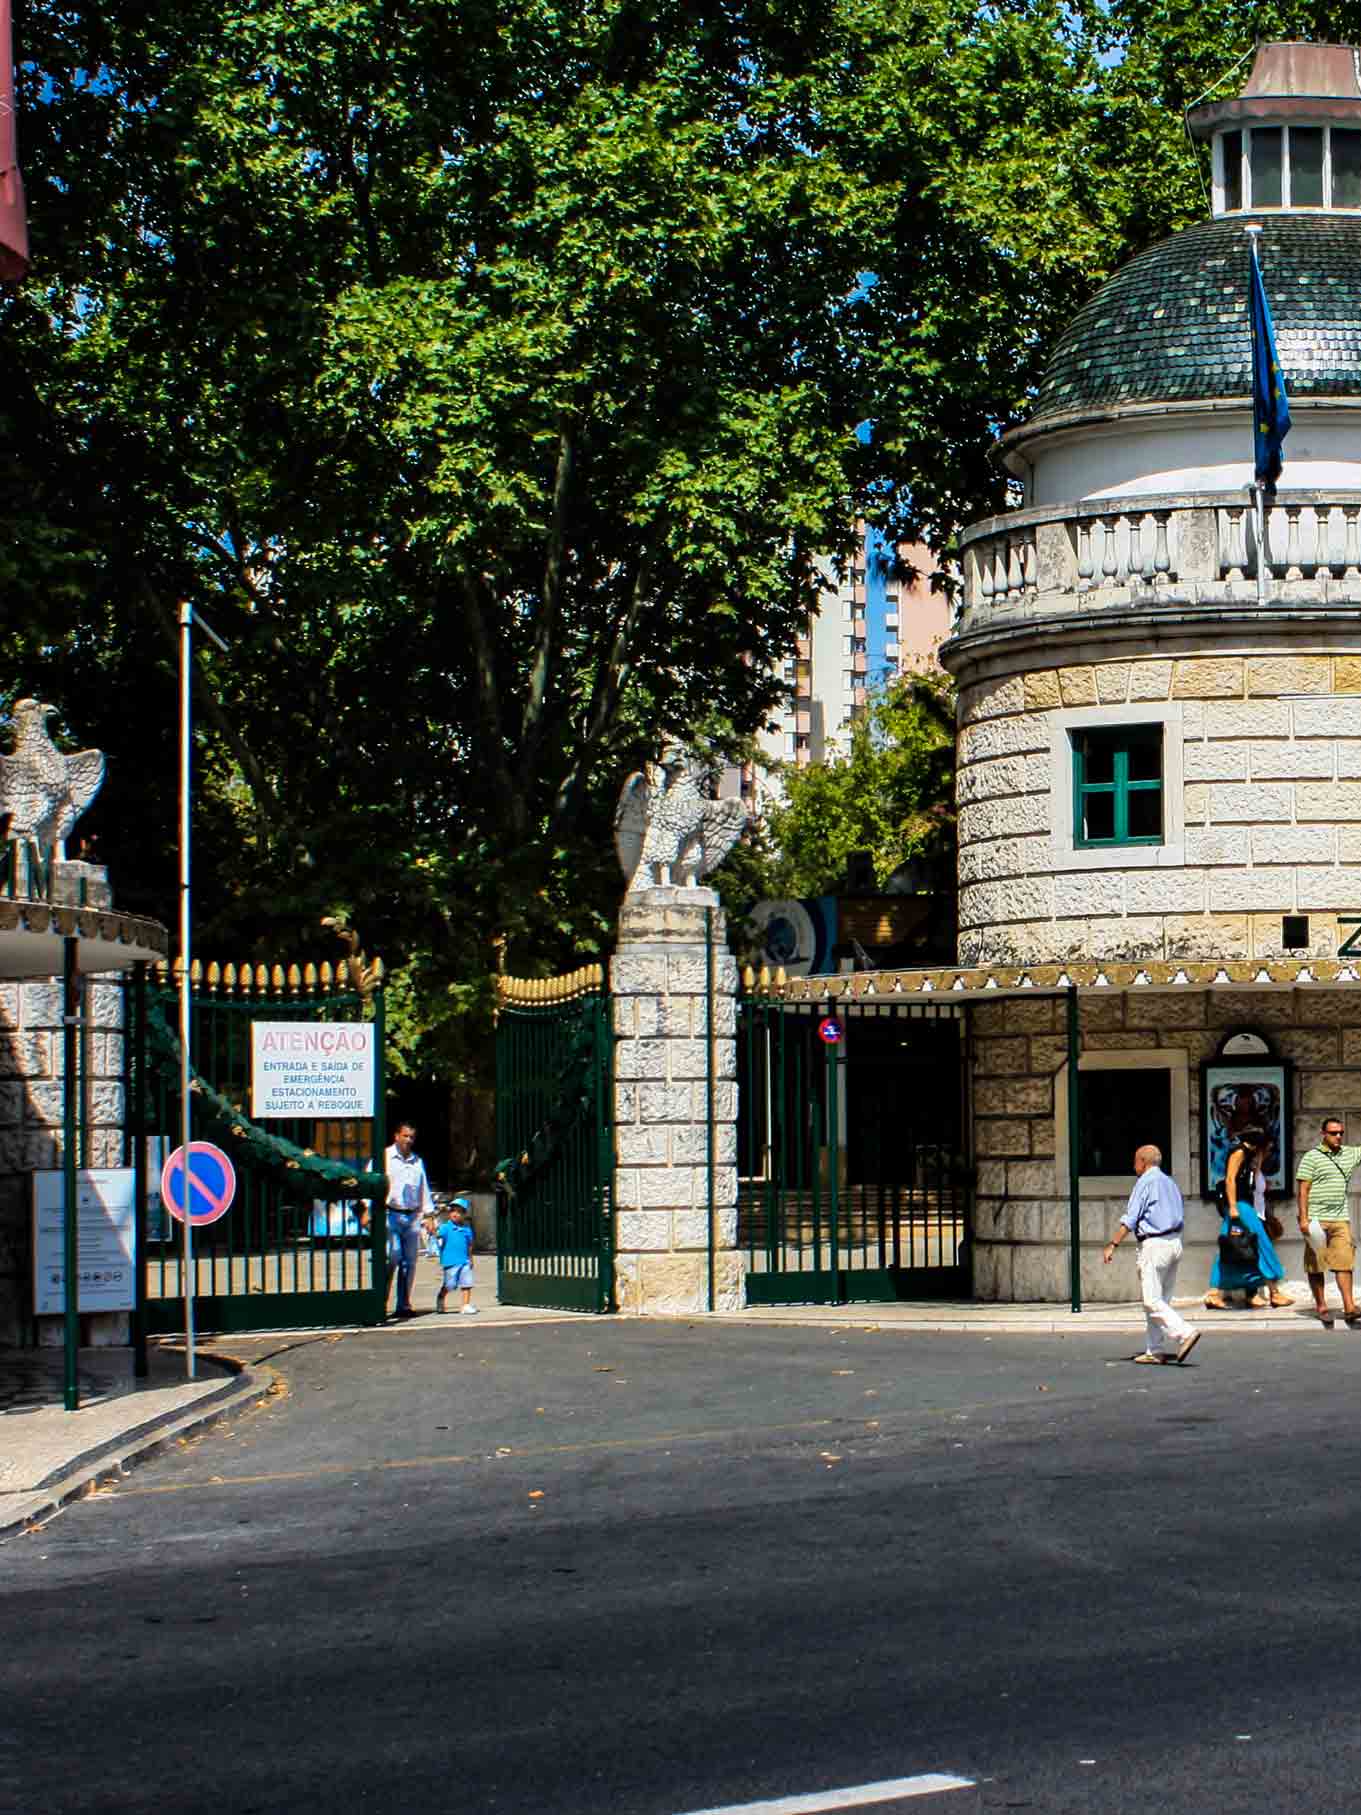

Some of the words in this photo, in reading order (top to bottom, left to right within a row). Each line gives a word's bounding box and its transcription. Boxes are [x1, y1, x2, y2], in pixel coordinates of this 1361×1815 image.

[262, 1026, 367, 1056] ATENÇÃO
[263, 1062, 308, 1071] ENTRADA
[311, 1062, 318, 1071] E
[321, 1060, 348, 1071] SAÍDA
[351, 1062, 365, 1071] DE
[283, 1072, 345, 1084] EMERGÊNCIA
[271, 1087, 357, 1097] ESTACIONAMENTO
[265, 1100, 305, 1110] SUJEITO
[307, 1100, 315, 1110] A
[319, 1100, 363, 1110] REBOQUE
